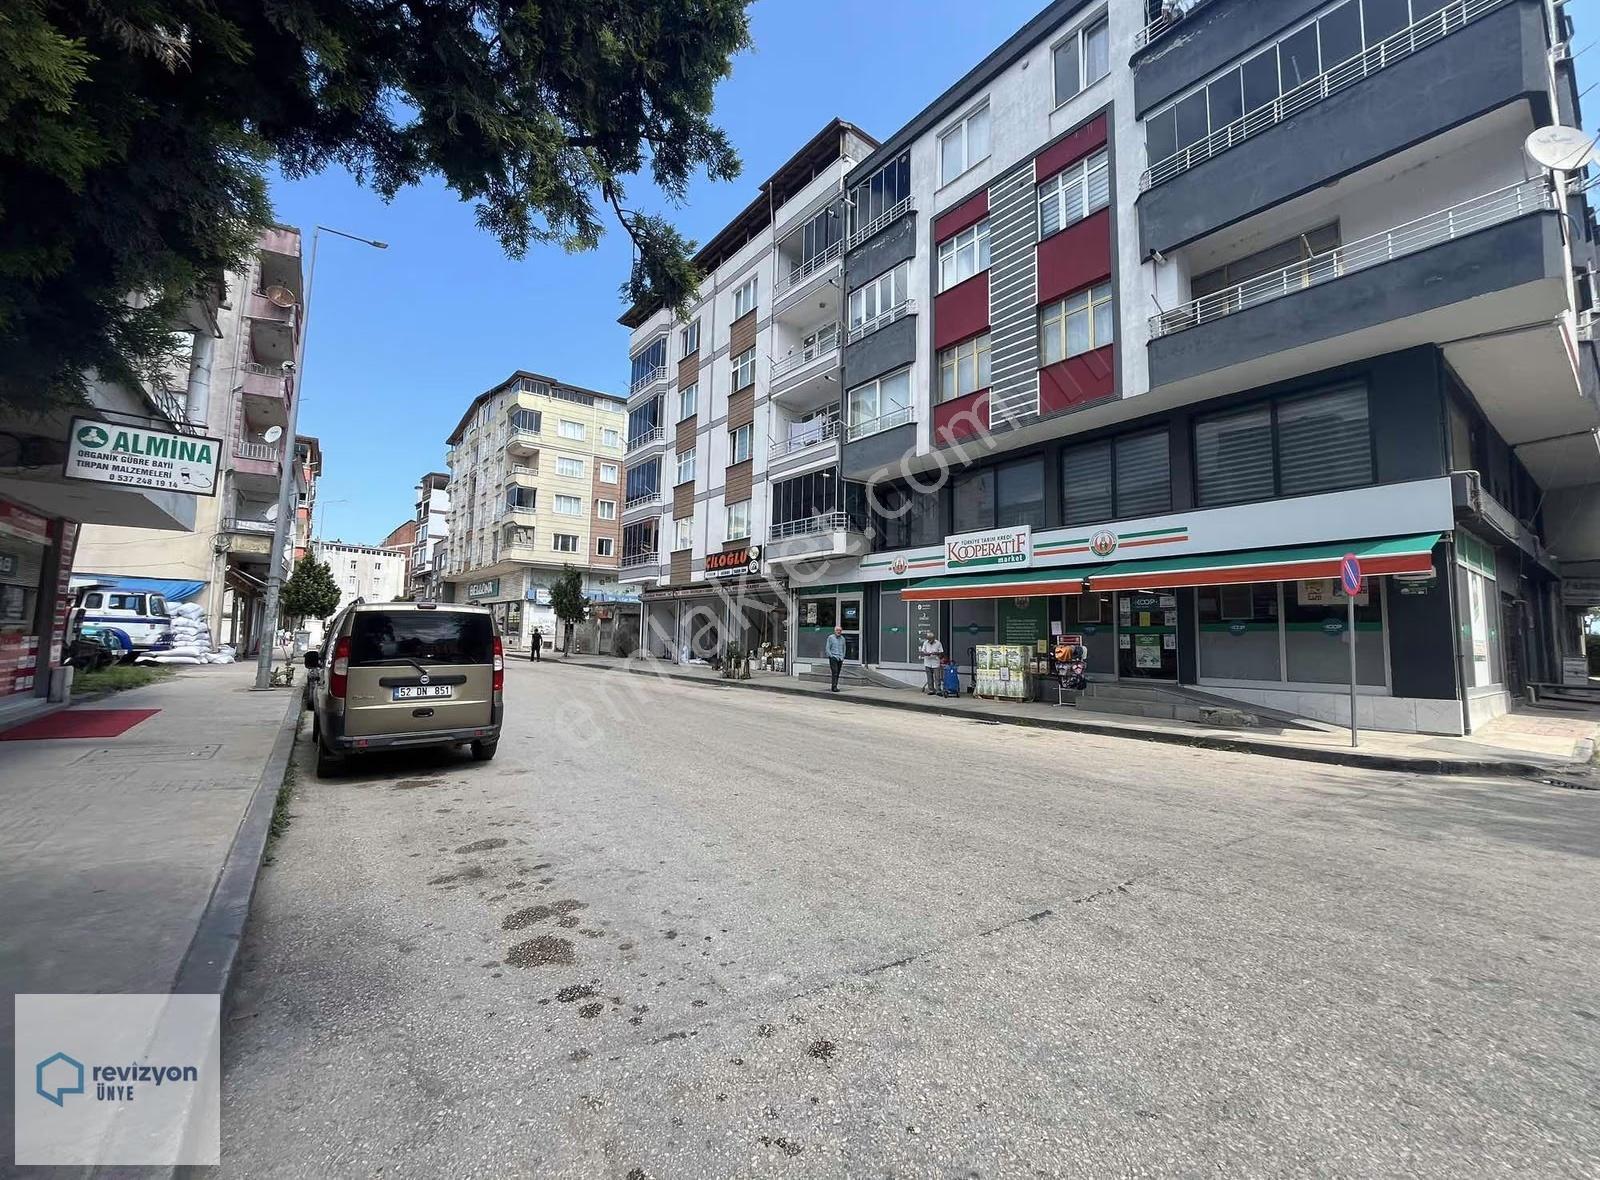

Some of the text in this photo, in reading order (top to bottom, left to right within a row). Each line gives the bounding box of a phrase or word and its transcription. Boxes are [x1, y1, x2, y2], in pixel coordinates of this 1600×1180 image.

[112, 431, 212, 464] ALMİNA
[117, 475, 134, 483] 537
[137, 477, 152, 485] 248
[169, 481, 178, 489] 14
[947, 533, 1026, 563] KOOPERATİF
[998, 554, 1023, 563] market
[400, 686, 449, 697] 52 DN 851
